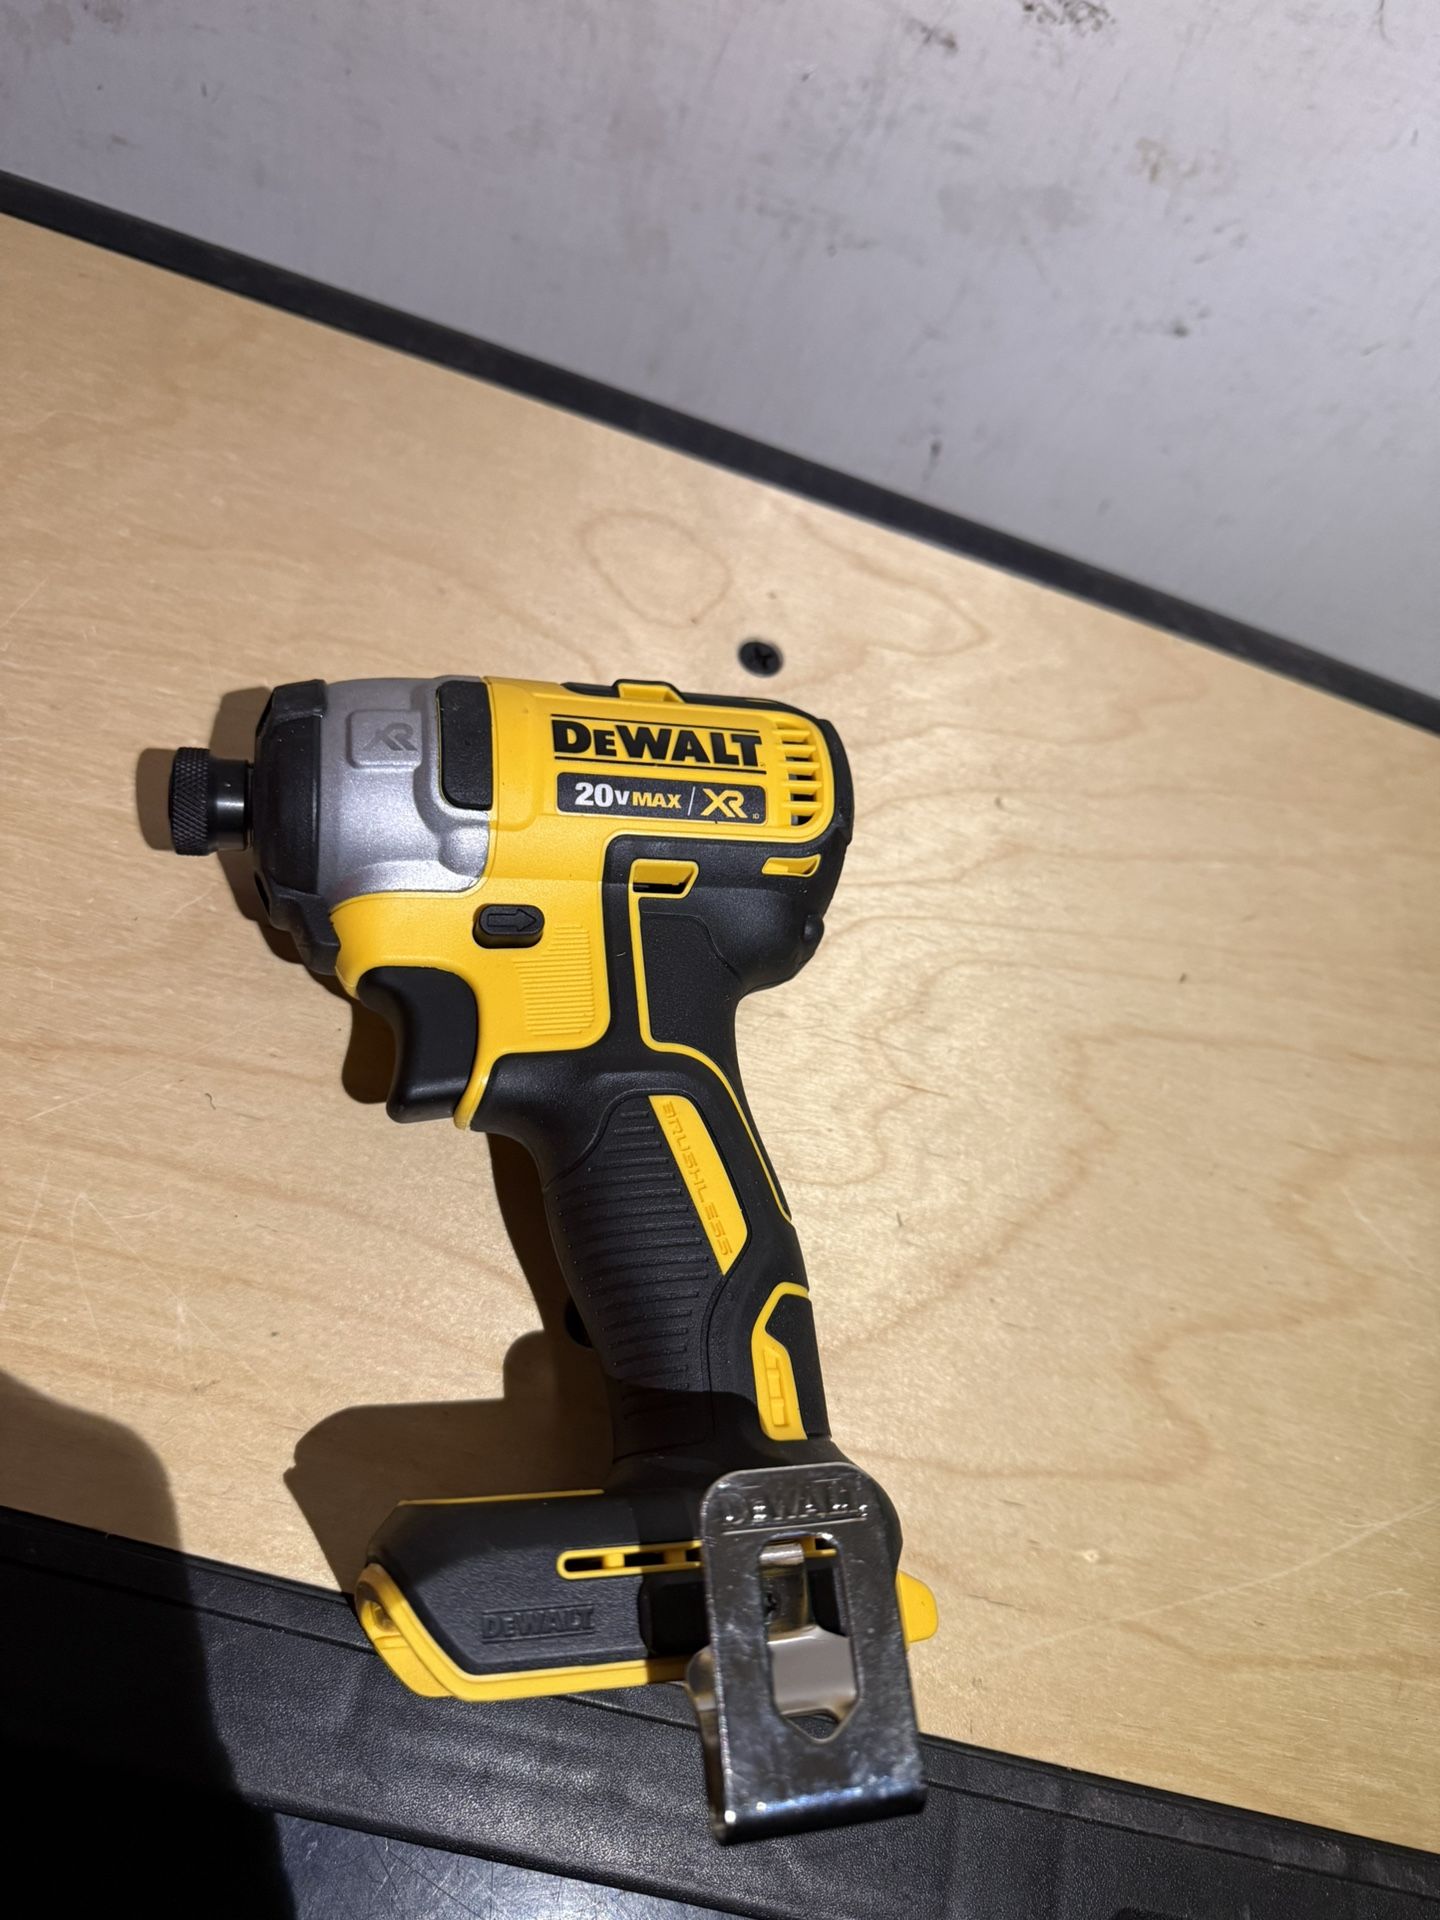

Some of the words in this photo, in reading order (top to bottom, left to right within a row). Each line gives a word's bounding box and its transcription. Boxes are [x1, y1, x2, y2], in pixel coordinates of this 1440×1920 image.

[361, 722, 418, 751] XR
[632, 790, 682, 809] MAX
[700, 788, 749, 819] XR
[662, 1100, 733, 1257] BRUSHLESS
